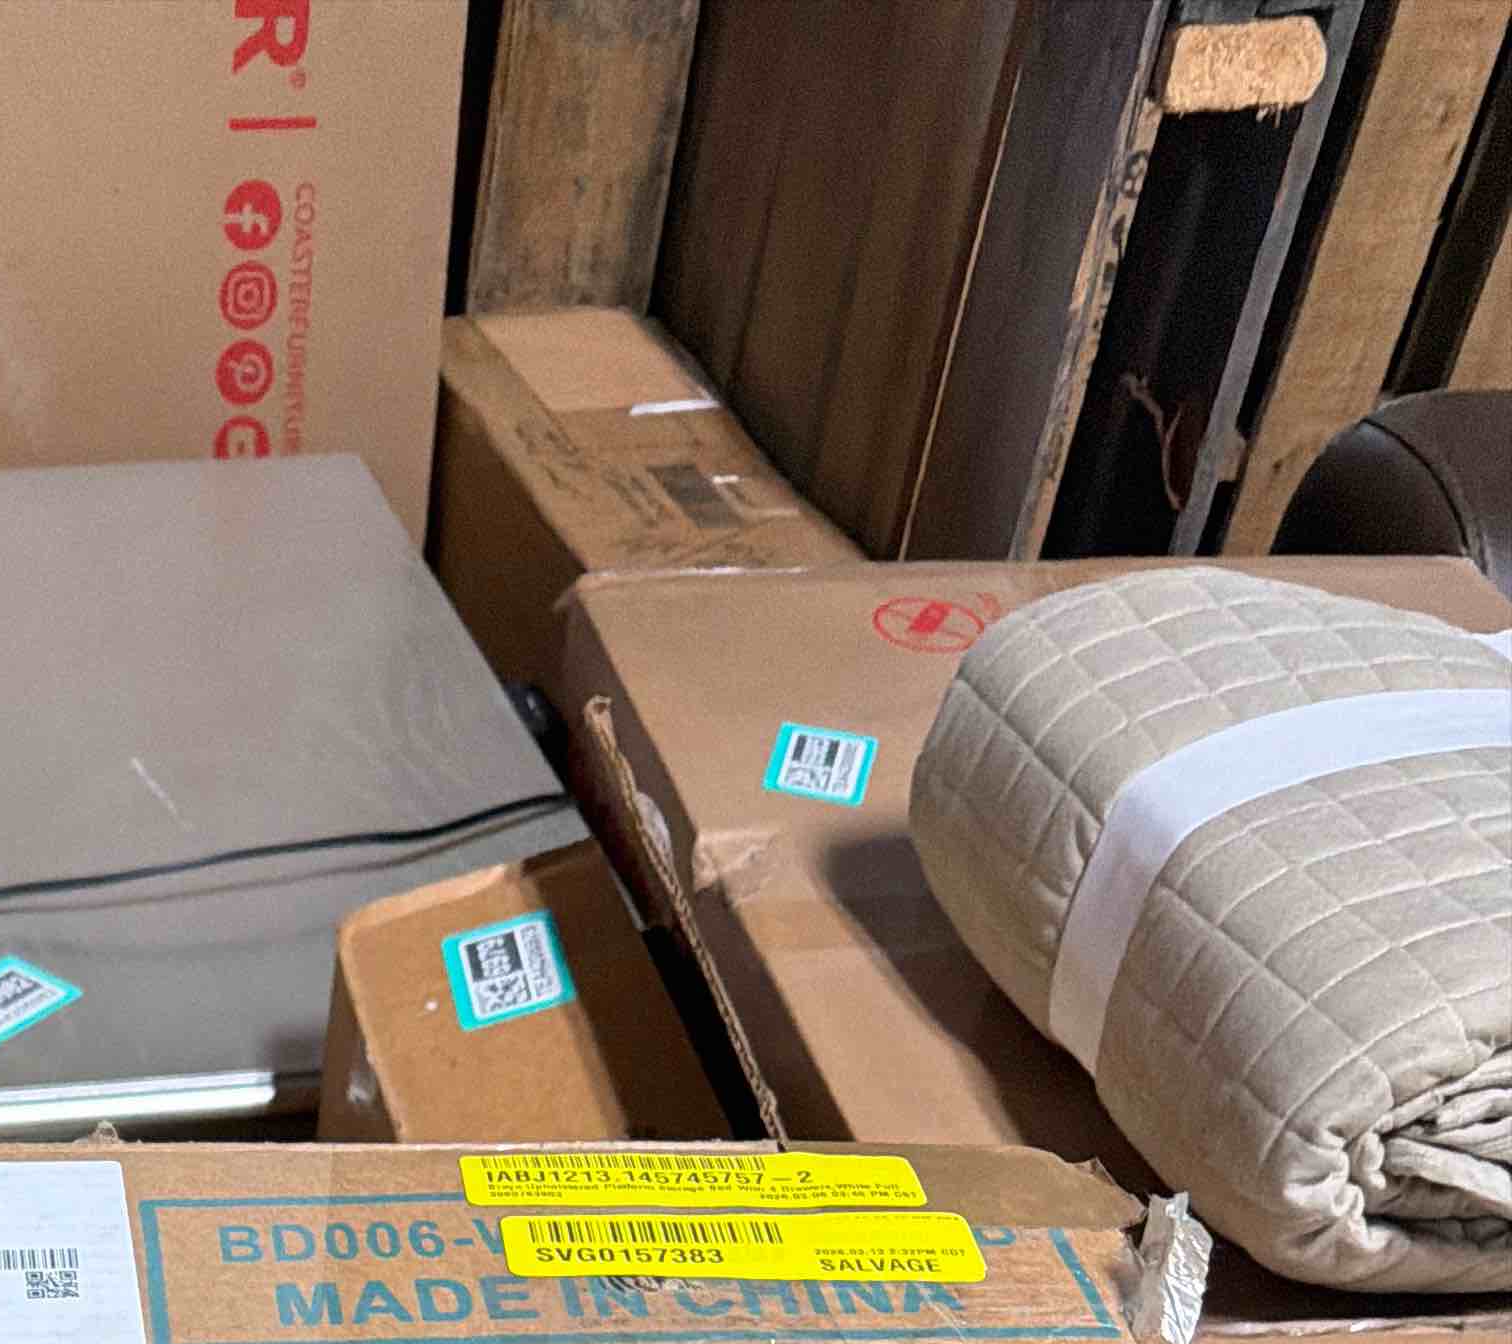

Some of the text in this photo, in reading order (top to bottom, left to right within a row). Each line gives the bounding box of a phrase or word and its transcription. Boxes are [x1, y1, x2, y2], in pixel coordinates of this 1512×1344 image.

[534, 1245, 726, 1265] SVG0157383
[819, 1257, 944, 1275] SALVAGE
[272, 1274, 542, 1329] MADE
